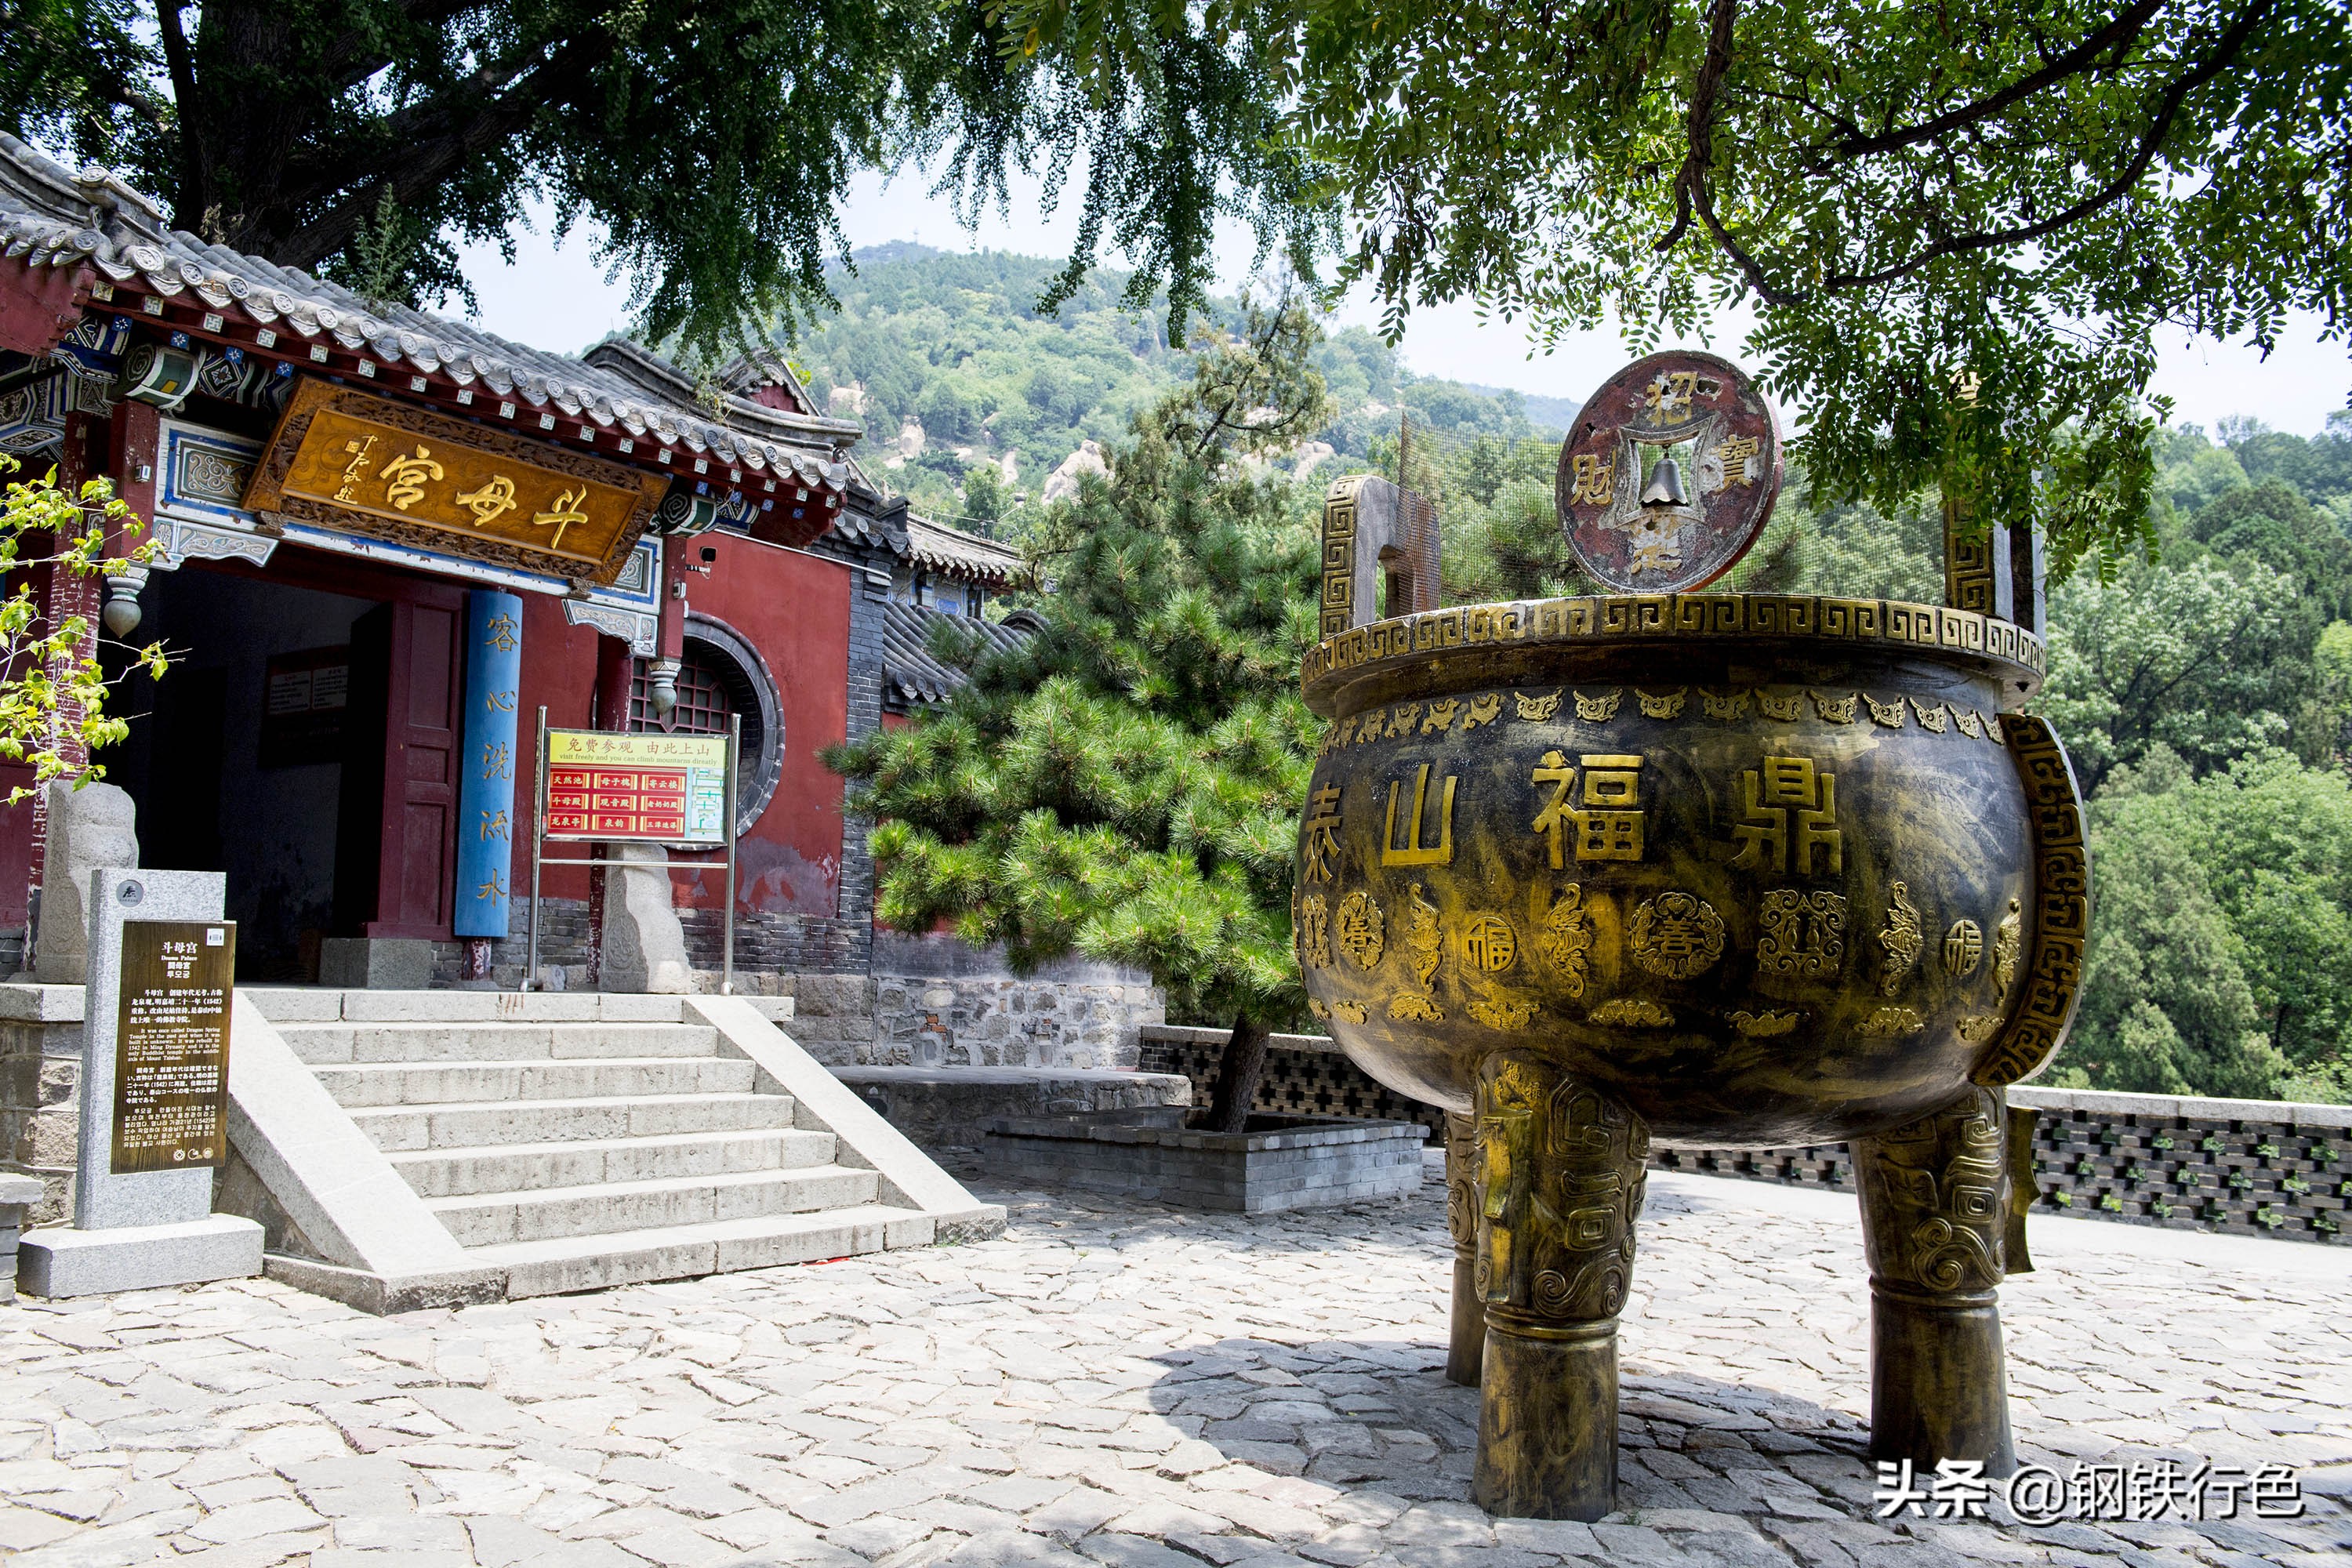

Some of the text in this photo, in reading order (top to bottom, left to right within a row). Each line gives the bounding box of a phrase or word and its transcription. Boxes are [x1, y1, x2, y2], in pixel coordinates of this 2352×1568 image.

[1645, 371, 1700, 428] 招
[1570, 448, 1617, 507] 財
[567, 737, 709, 756] 免费参观 由此上山
[477, 612, 519, 908] 客心洗流水
[575, 753, 594, 761] freely
[553, 775, 583, 785] 天然池
[552, 796, 582, 806] 斗母殿
[600, 797, 630, 808] 观音殿
[551, 816, 580, 826] 龙泉亭
[1302, 750, 1842, 884] 泰山福鼎
[161, 941, 198, 953] 斗母宫
[1462, 916, 1517, 973] 福
